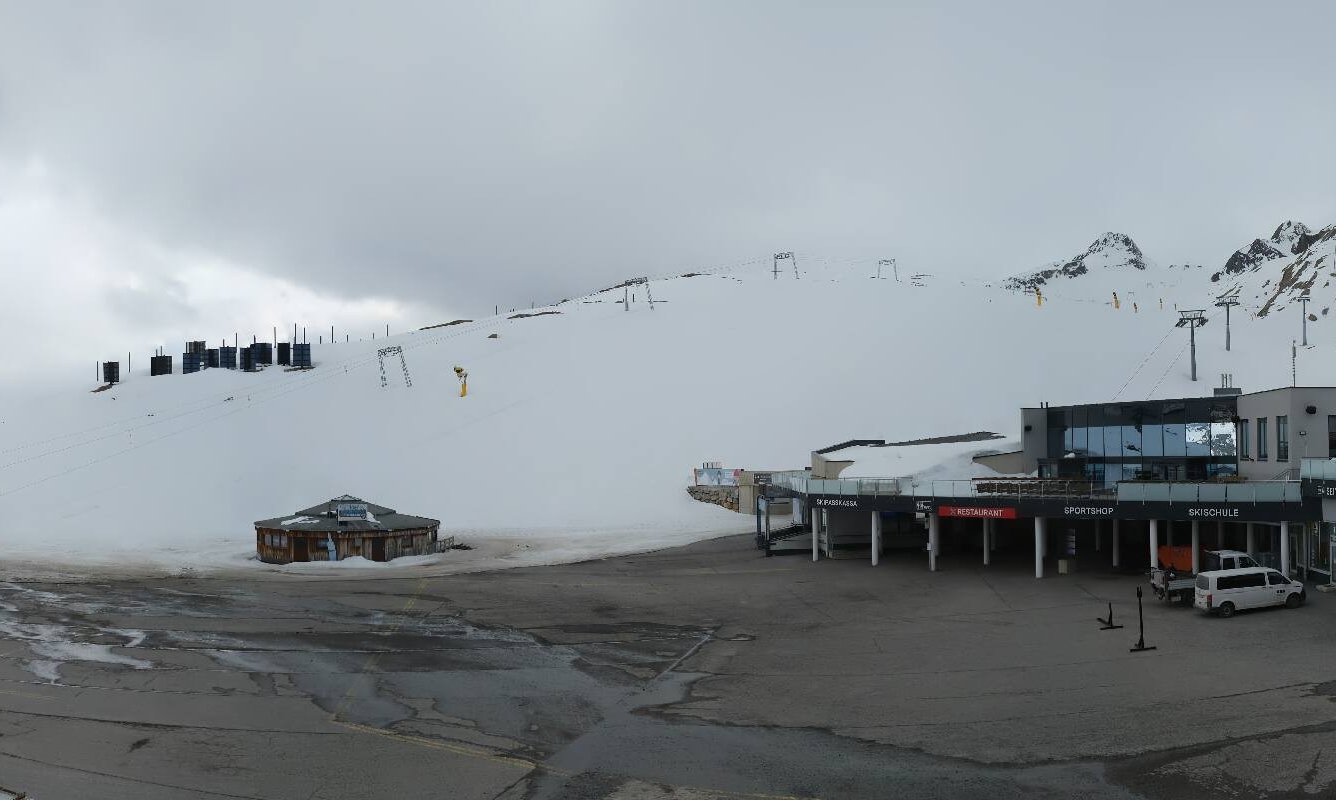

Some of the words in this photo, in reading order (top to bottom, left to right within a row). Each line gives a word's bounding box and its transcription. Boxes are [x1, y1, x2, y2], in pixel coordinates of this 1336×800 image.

[816, 498, 858, 507] SKIPASSKASSA
[957, 507, 1004, 517] RESTAURANT
[1064, 506, 1114, 515] SPORTSHOP
[1188, 508, 1239, 517] SKISCHULE
